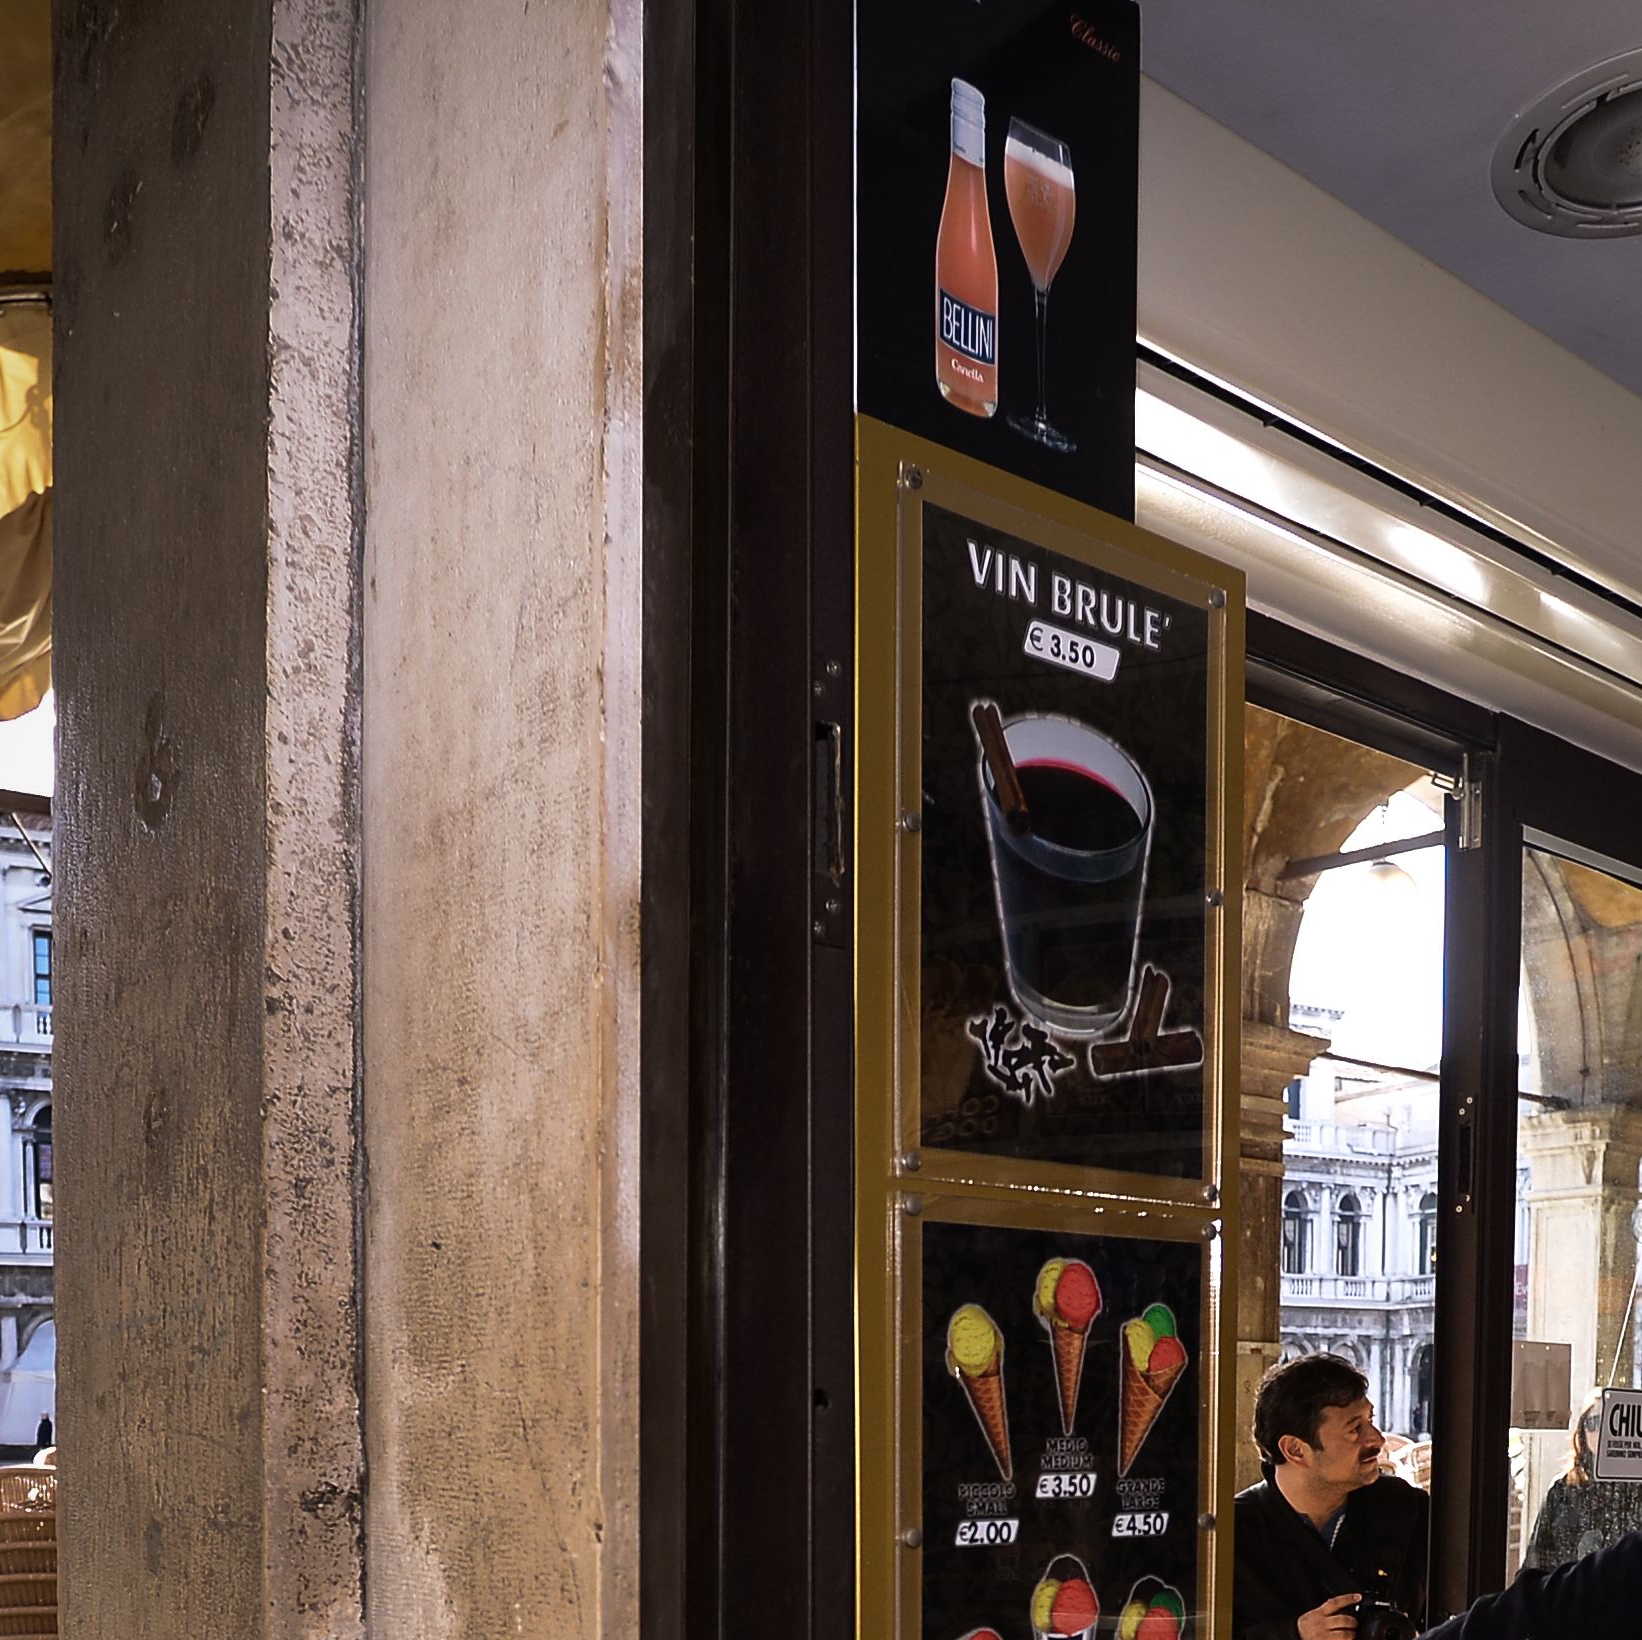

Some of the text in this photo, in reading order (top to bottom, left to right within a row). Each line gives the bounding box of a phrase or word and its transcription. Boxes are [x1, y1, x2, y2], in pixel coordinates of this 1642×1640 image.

[942, 296, 992, 359] BELLINI
[967, 539, 1171, 649] VIN BRULE'
[1049, 634, 1096, 668] 3.50
[1046, 1438, 1088, 1453] MEDIO
[1042, 1454, 1093, 1469] MEDIUM
[958, 1483, 1015, 1500] PICCOLO
[1116, 1478, 1165, 1494] GRANDE
[966, 1500, 1008, 1516] SMALL
[1122, 1493, 1160, 1510] LARGE
